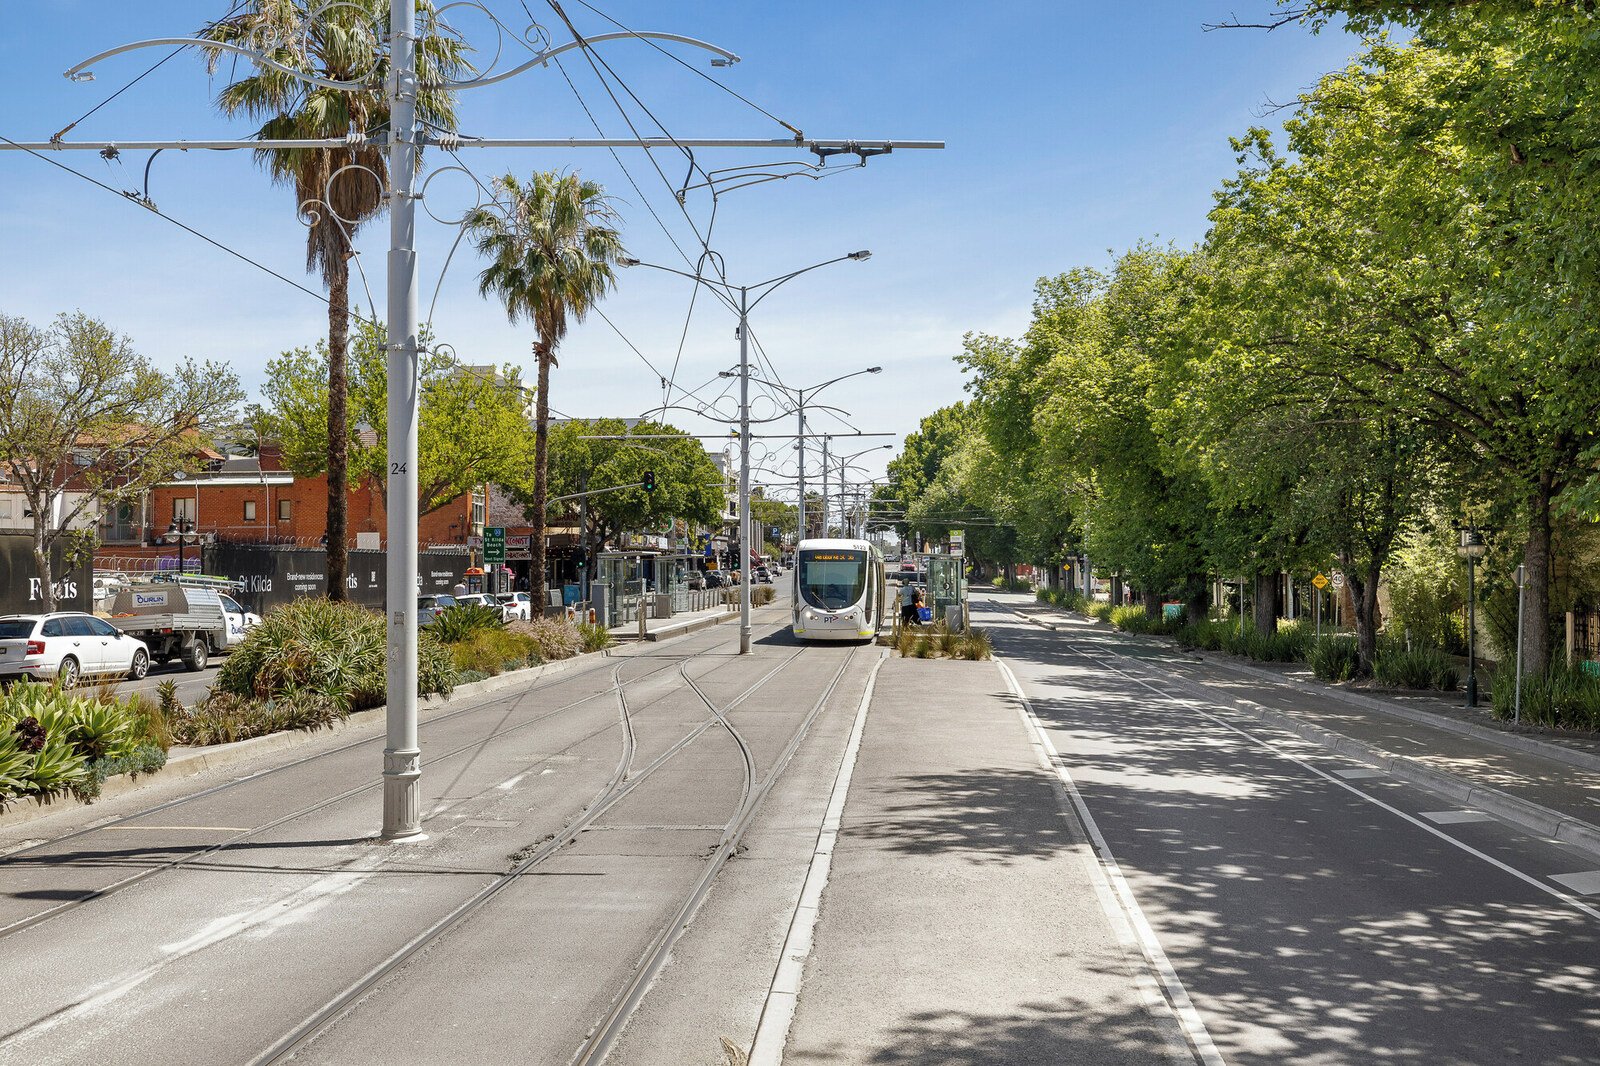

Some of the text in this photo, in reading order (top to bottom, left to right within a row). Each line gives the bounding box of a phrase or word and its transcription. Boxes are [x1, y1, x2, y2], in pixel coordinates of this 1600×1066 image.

[391, 462, 407, 475] 24
[286, 572, 324, 581] Brand-new residences
[251, 575, 272, 592] Kilda
[294, 583, 307, 592] coming
